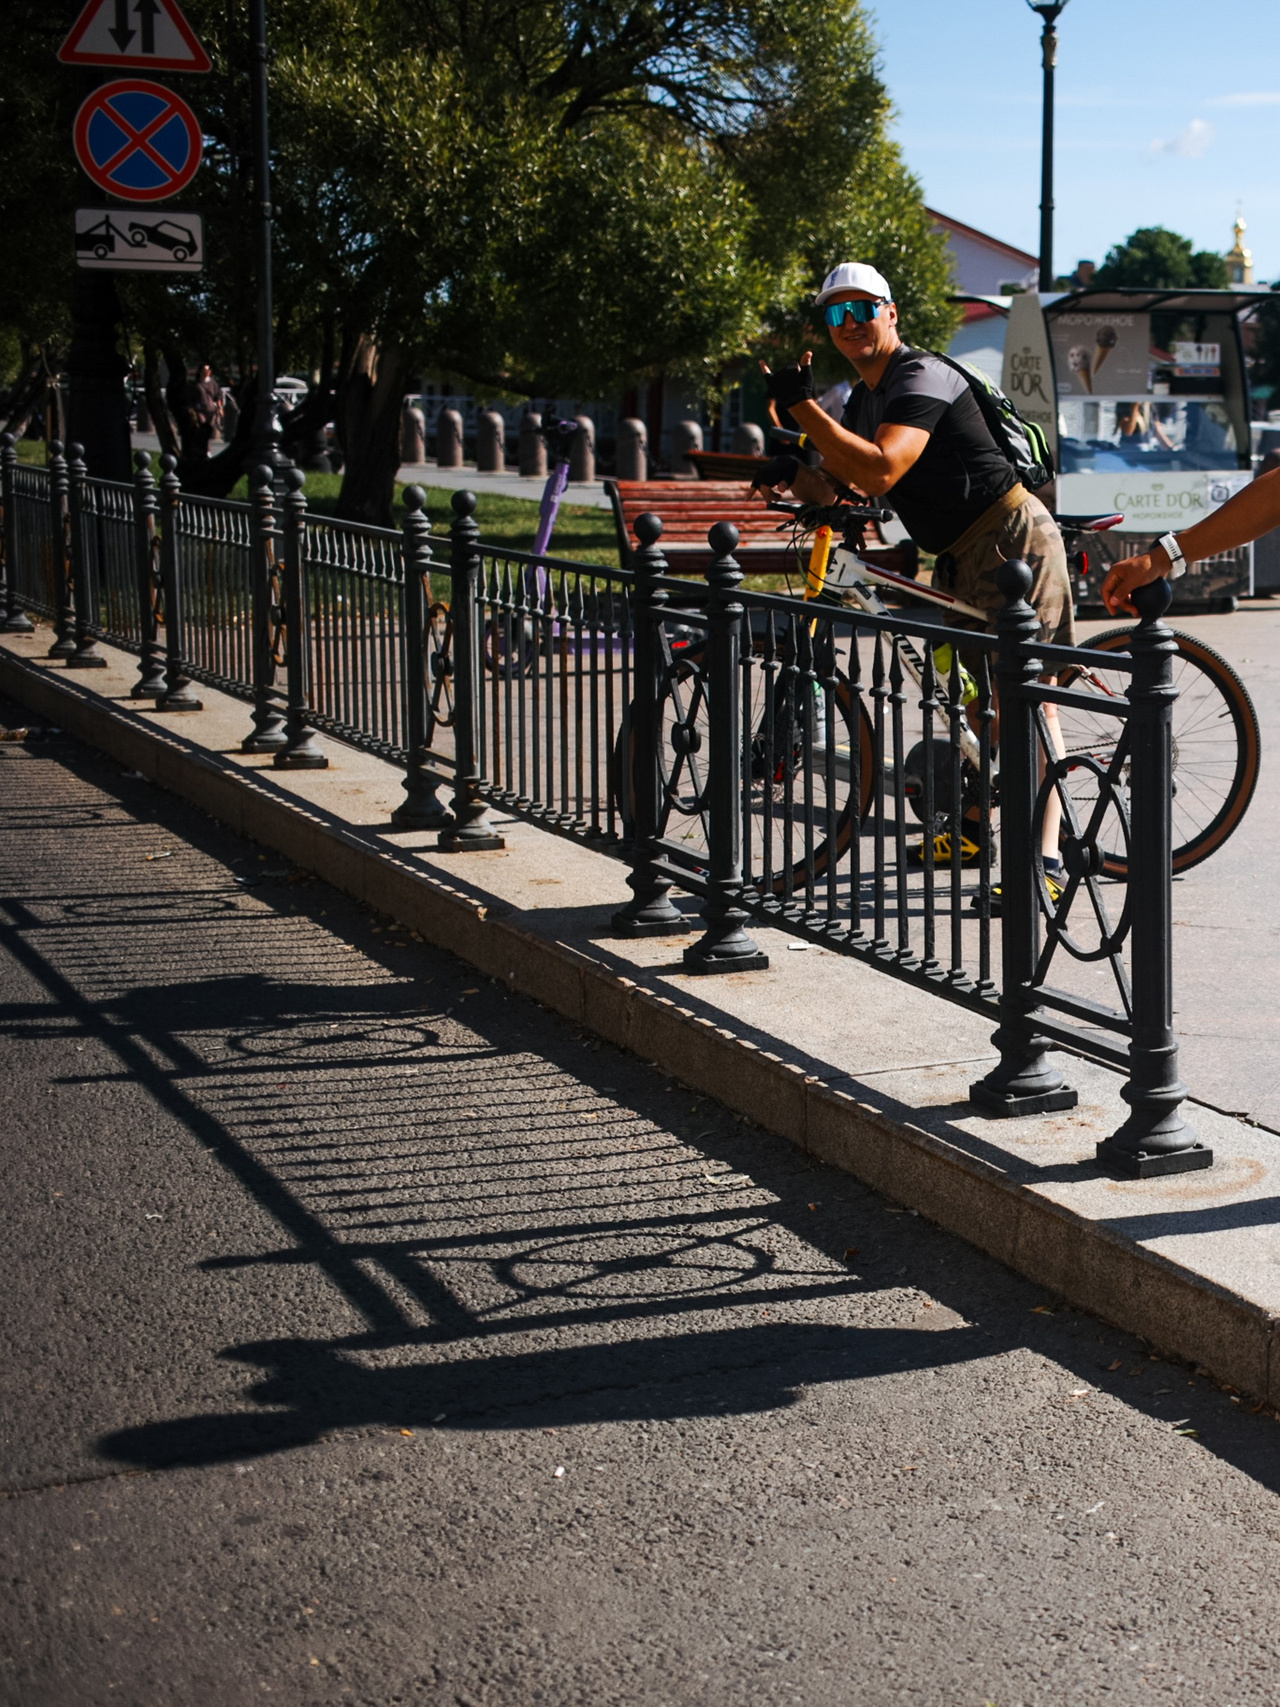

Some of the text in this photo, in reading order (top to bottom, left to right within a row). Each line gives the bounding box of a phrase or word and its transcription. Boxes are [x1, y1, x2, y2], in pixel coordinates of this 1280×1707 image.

[1057, 314, 1134, 327] МОРОЖЕНОЕ
[1011, 354, 1042, 371] CARTE
[1114, 491, 1204, 511] CARTE D'OR
[1132, 511, 1183, 520] МОРОЖЕНОЕ
